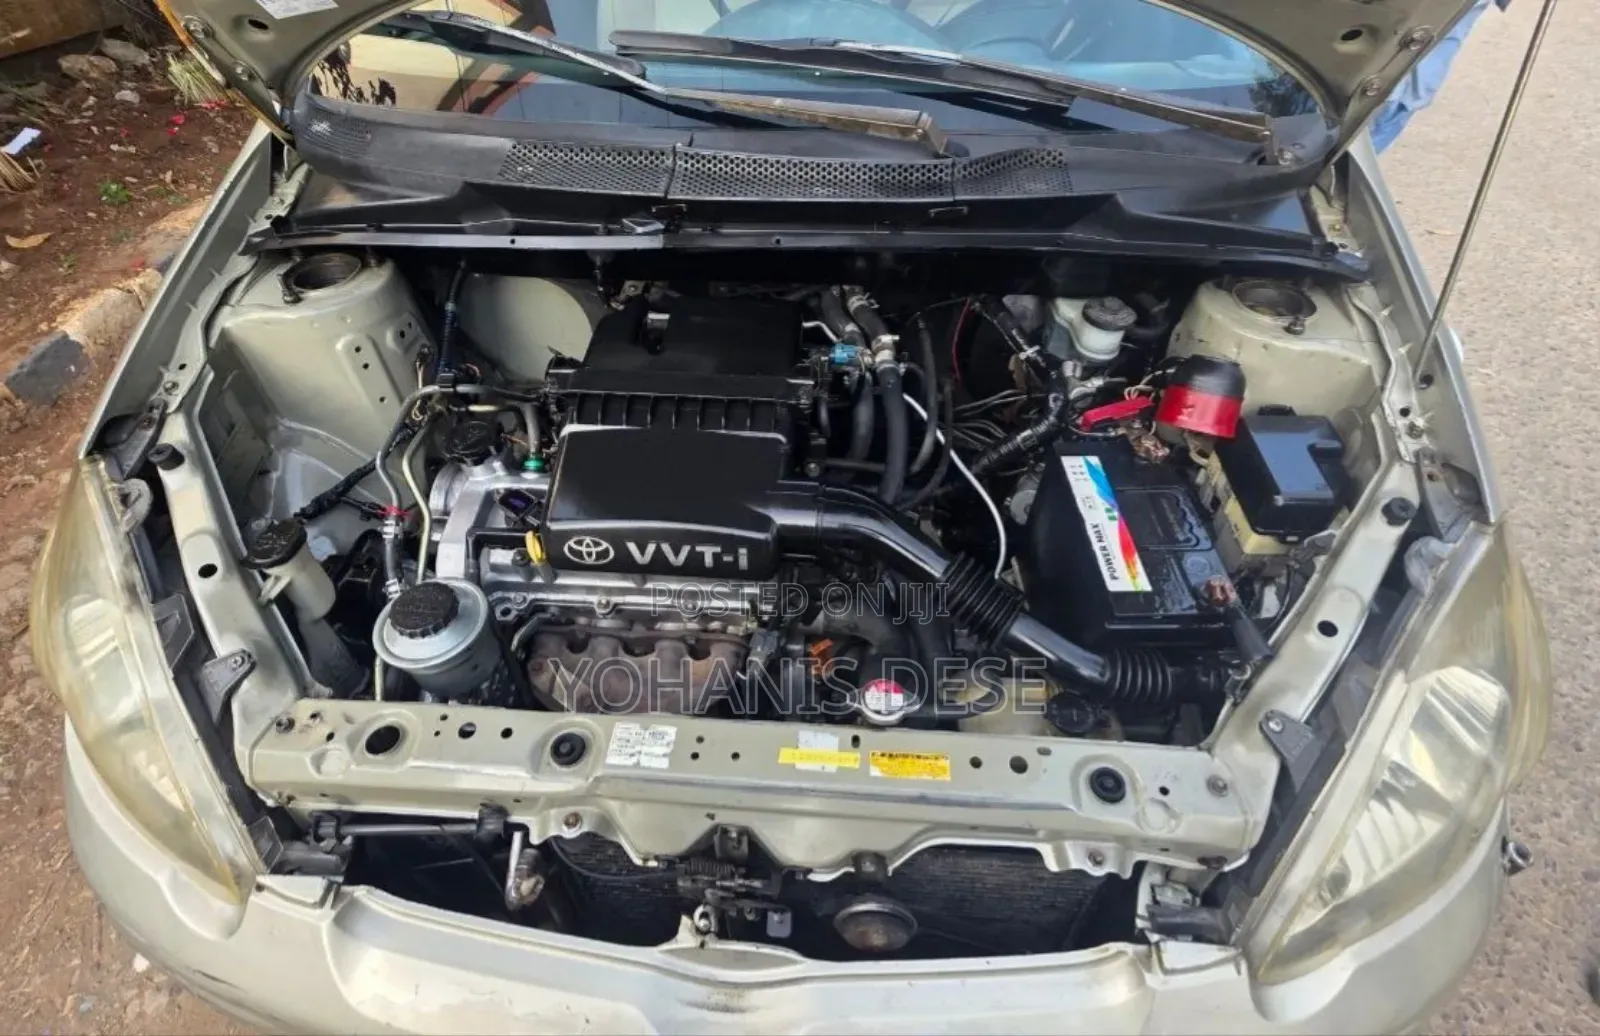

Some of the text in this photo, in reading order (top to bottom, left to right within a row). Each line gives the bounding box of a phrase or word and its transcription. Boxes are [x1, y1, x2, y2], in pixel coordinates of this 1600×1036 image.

[1092, 523, 1105, 543] MAX
[625, 540, 749, 571] VVT-i
[1099, 545, 1119, 580] POWER
